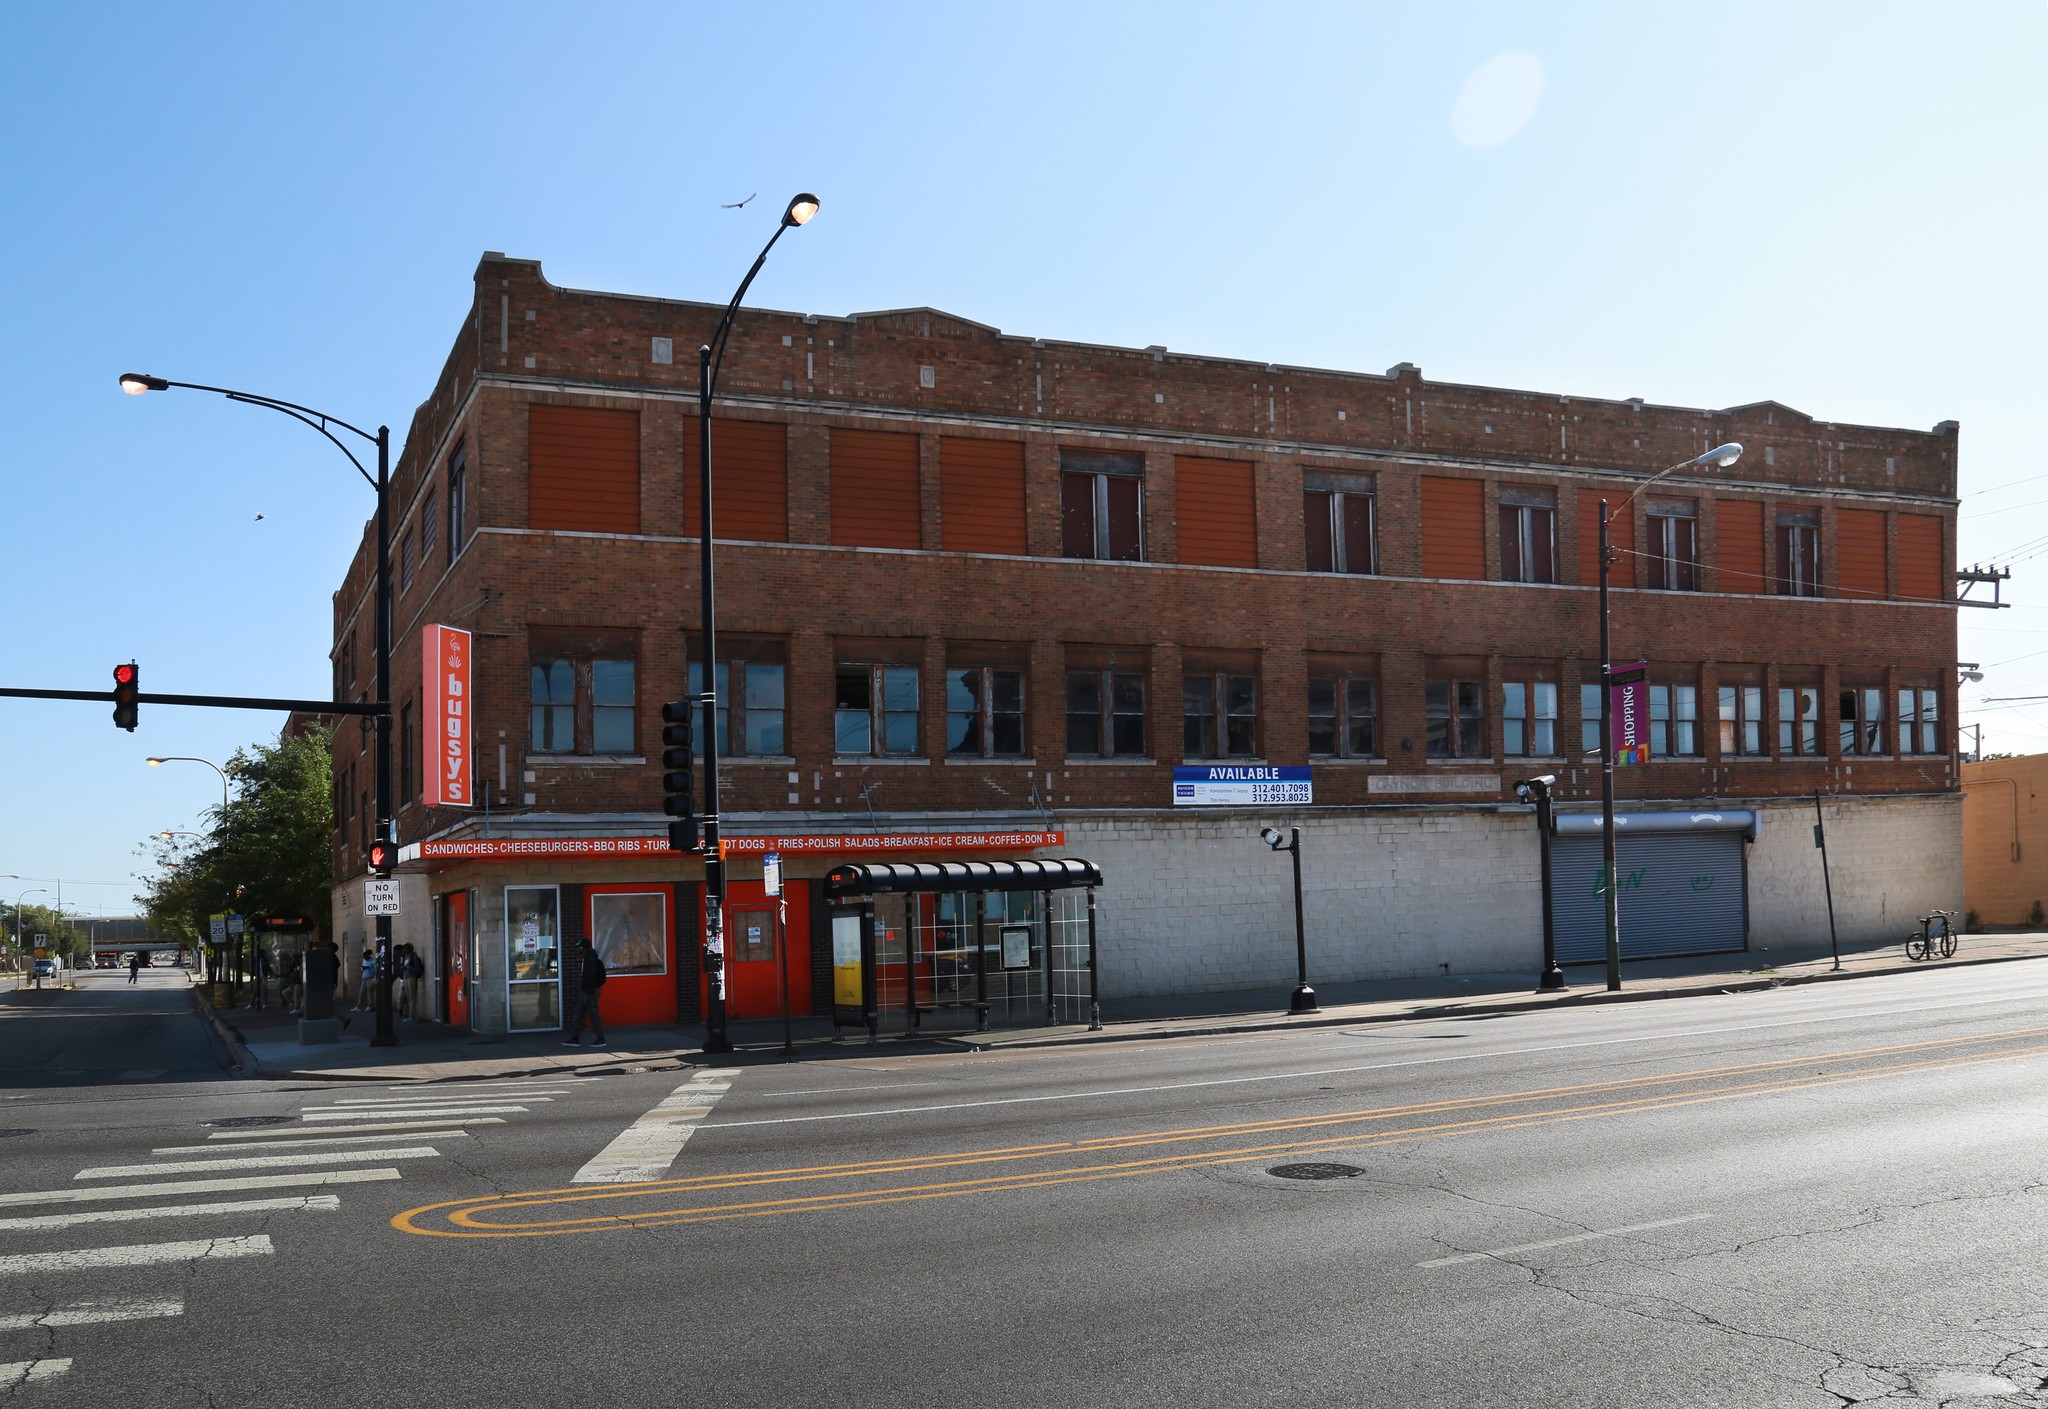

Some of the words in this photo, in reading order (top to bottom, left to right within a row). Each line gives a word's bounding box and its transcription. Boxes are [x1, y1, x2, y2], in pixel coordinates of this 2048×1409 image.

[1623, 686, 1635, 747] SHOPPING
[447, 673, 463, 800] bugsy's
[1208, 767, 1279, 780] AVAILABLE
[1252, 784, 1309, 793] 312.401.7098
[1434, 778, 1492, 789] BUILDING
[1252, 793, 1309, 802] 312.953.8025
[618, 840, 640, 850] RIBS
[739, 839, 765, 849] DOGS
[375, 884, 389, 892] NO
[382, 903, 398, 911] RED
[212, 927, 224, 935] 20
